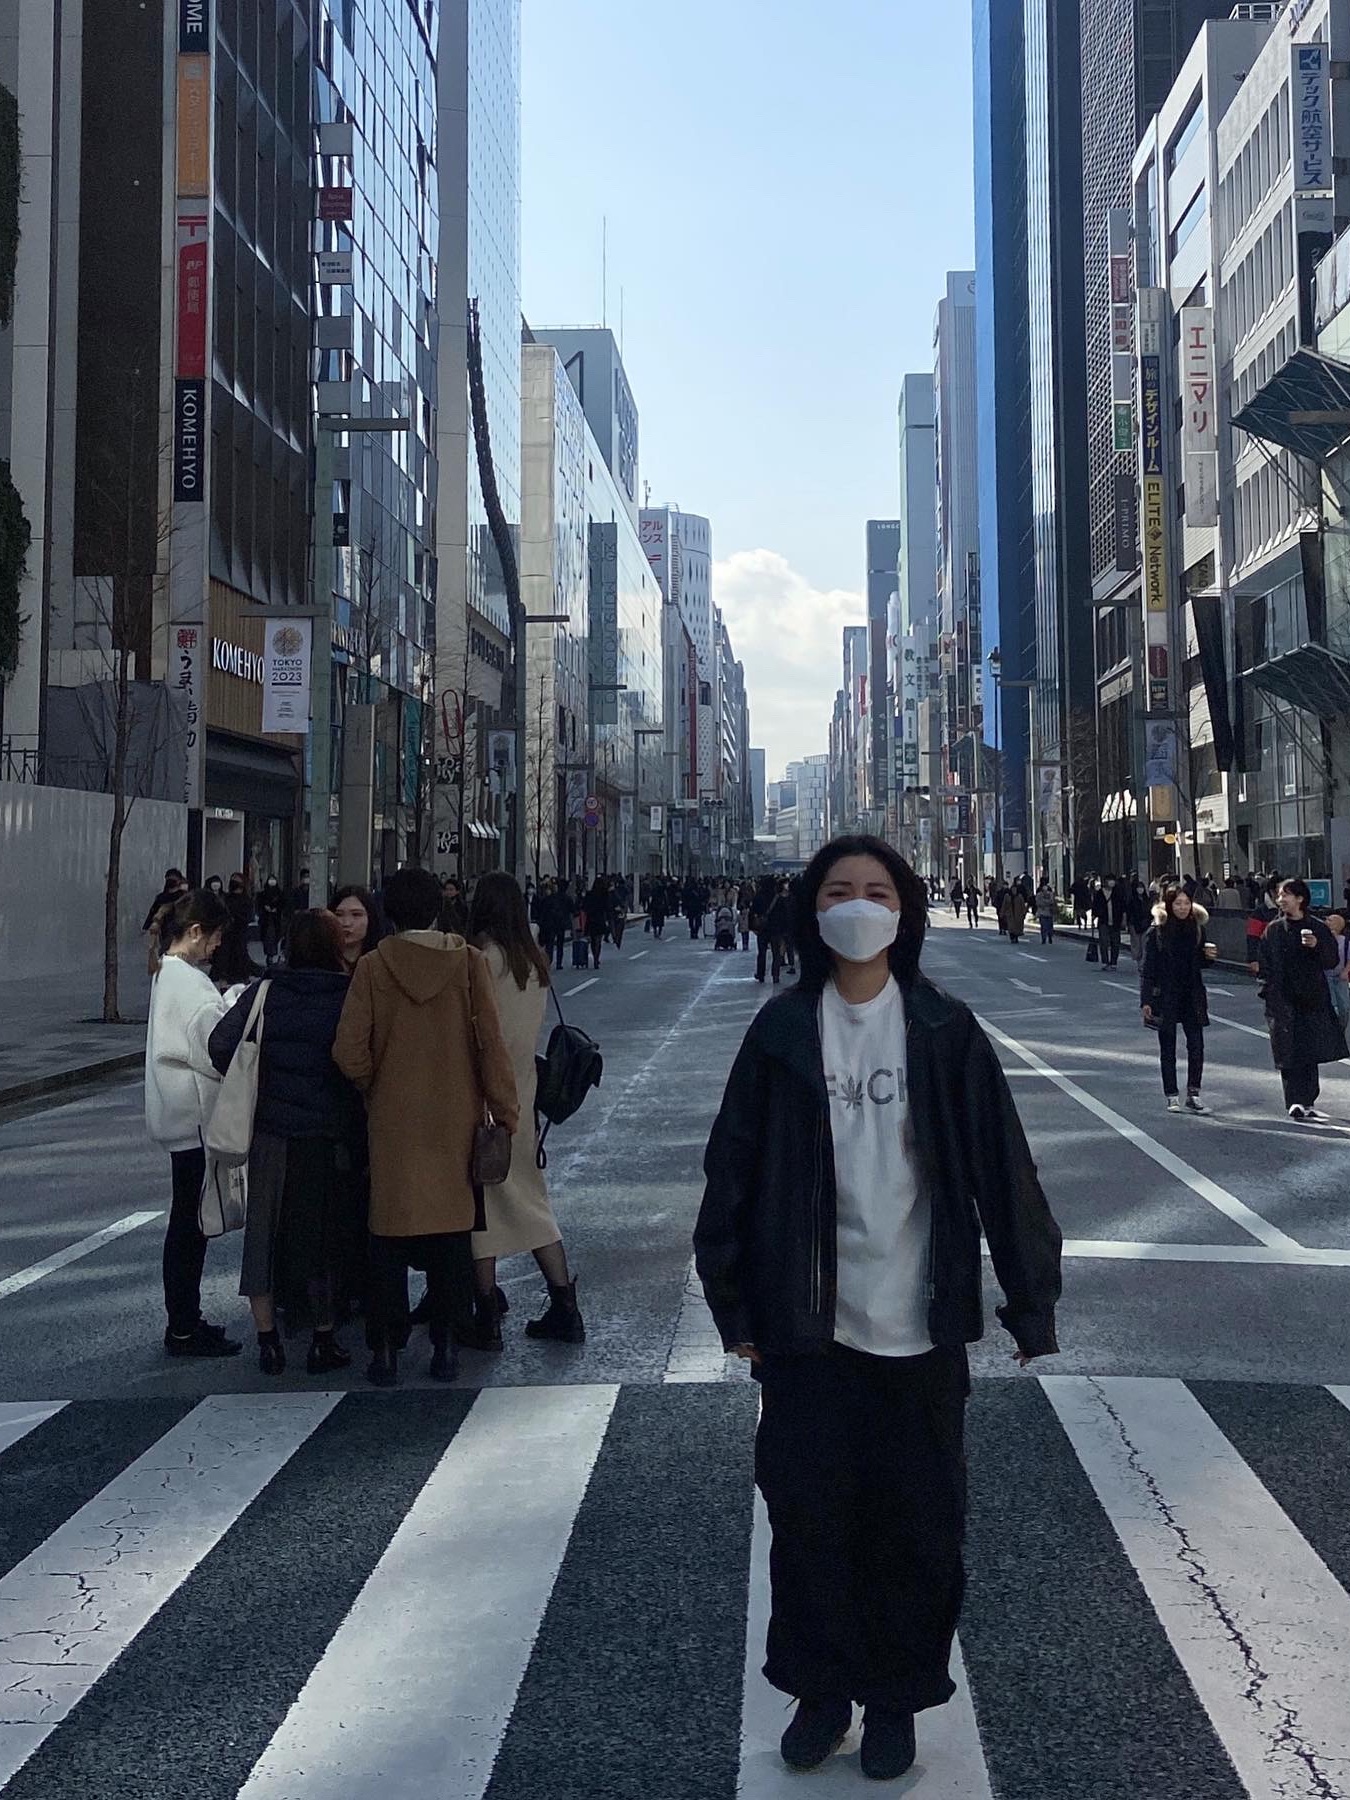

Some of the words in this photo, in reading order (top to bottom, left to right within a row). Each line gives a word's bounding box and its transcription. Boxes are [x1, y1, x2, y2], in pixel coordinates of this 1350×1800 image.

[185, 0, 203, 33] ME
[1301, 72, 1323, 186] テック航空サービス
[1189, 327, 1209, 433] エニマリ
[182, 389, 197, 489] KOMEHYO
[1145, 368, 1159, 472] 旅のデザインルーム
[1147, 483, 1161, 527] ELITE
[1149, 546, 1164, 607] Network
[213, 637, 264, 684] KOMEHYO
[273, 659, 302, 667] TOKYO
[273, 672, 302, 682] 2023
[905, 649, 915, 711] 教文館
